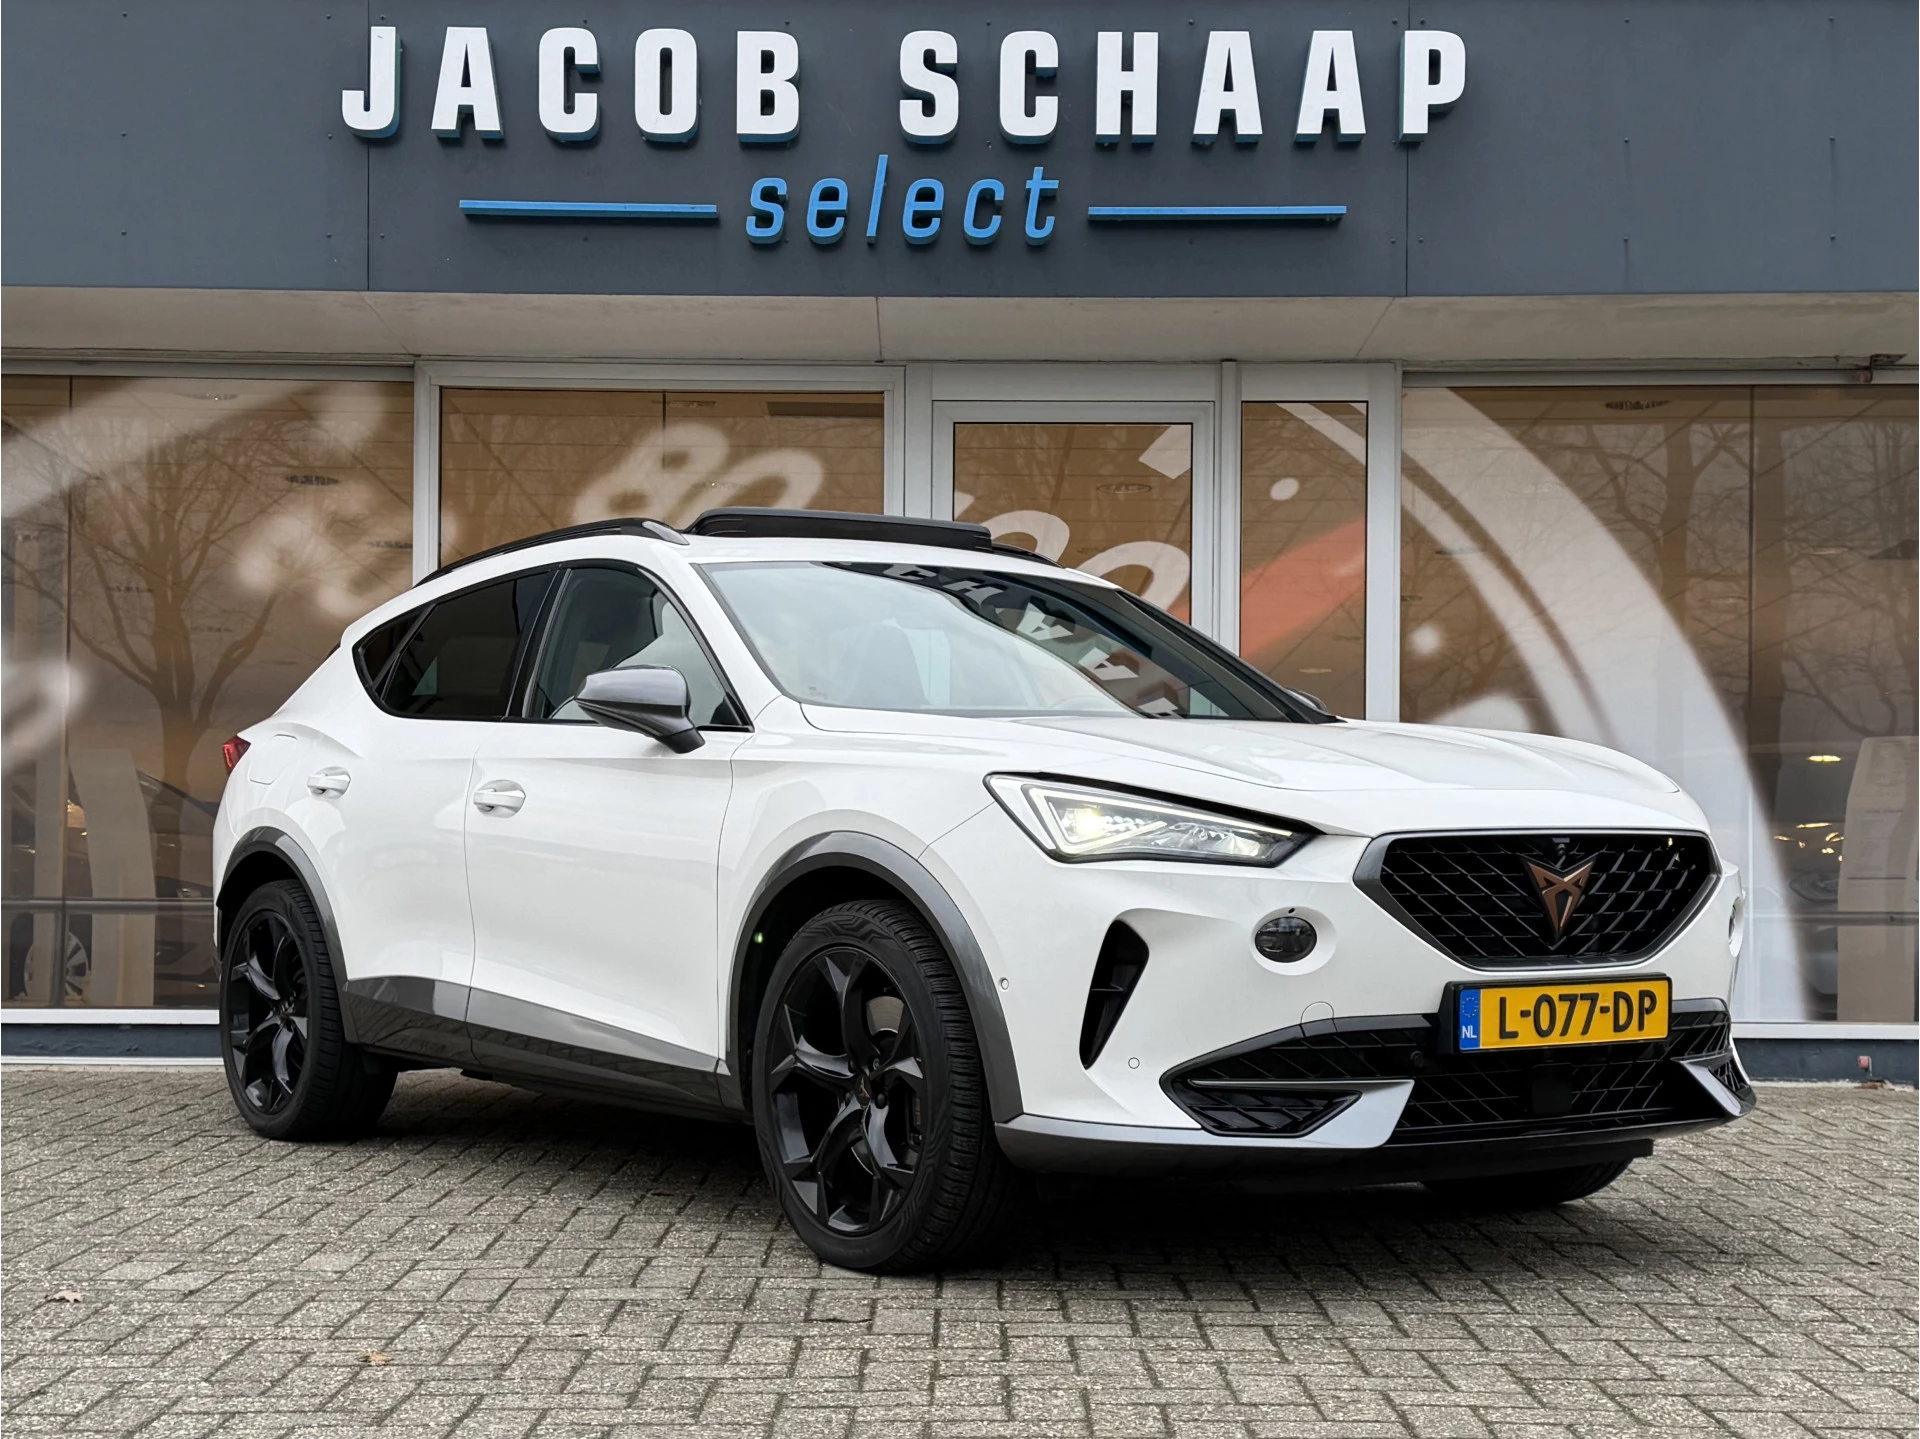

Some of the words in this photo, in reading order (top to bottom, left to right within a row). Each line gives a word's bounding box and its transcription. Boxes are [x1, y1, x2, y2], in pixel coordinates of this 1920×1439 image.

[341, 26, 801, 141] JACOB
[899, 30, 1466, 142] SCHAAP
[745, 154, 1059, 245] select
[1461, 1025, 1477, 1039] NL
[1498, 989, 1658, 1040] L-077-DP
